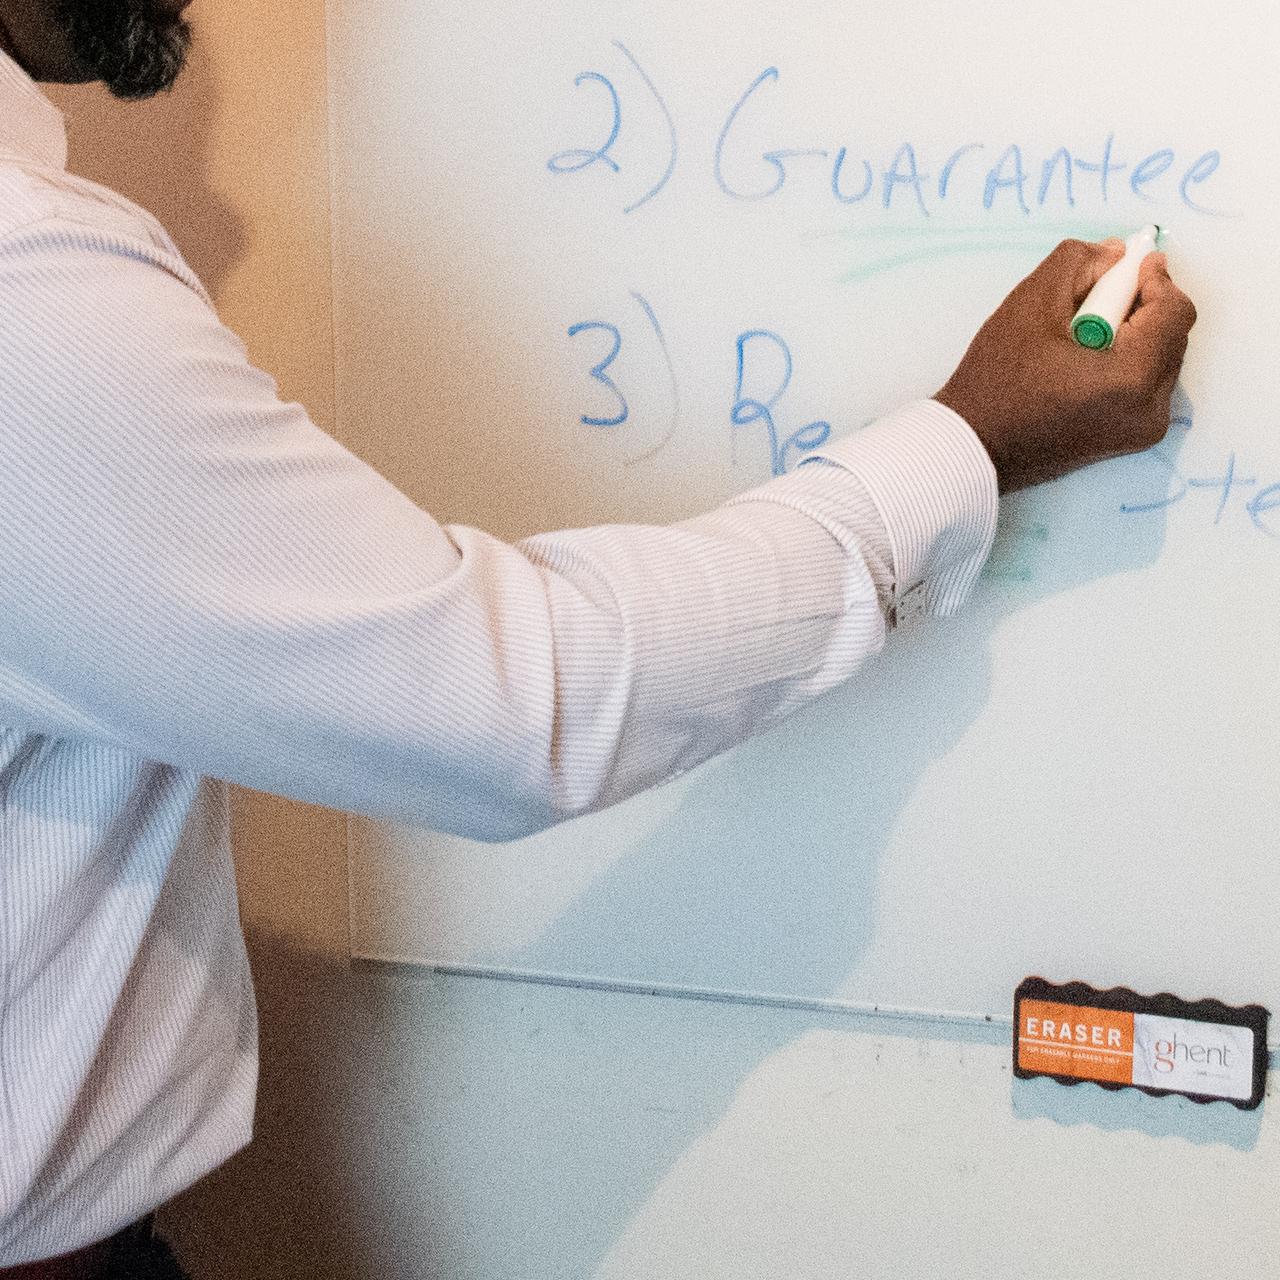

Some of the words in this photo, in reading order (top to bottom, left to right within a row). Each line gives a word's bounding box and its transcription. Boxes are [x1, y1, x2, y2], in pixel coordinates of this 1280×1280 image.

[546, 40, 678, 214] 2)
[567, 292, 680, 467] 3)
[1026, 1017, 1122, 1048] ERASER
[1153, 1033, 1231, 1074] ghent
